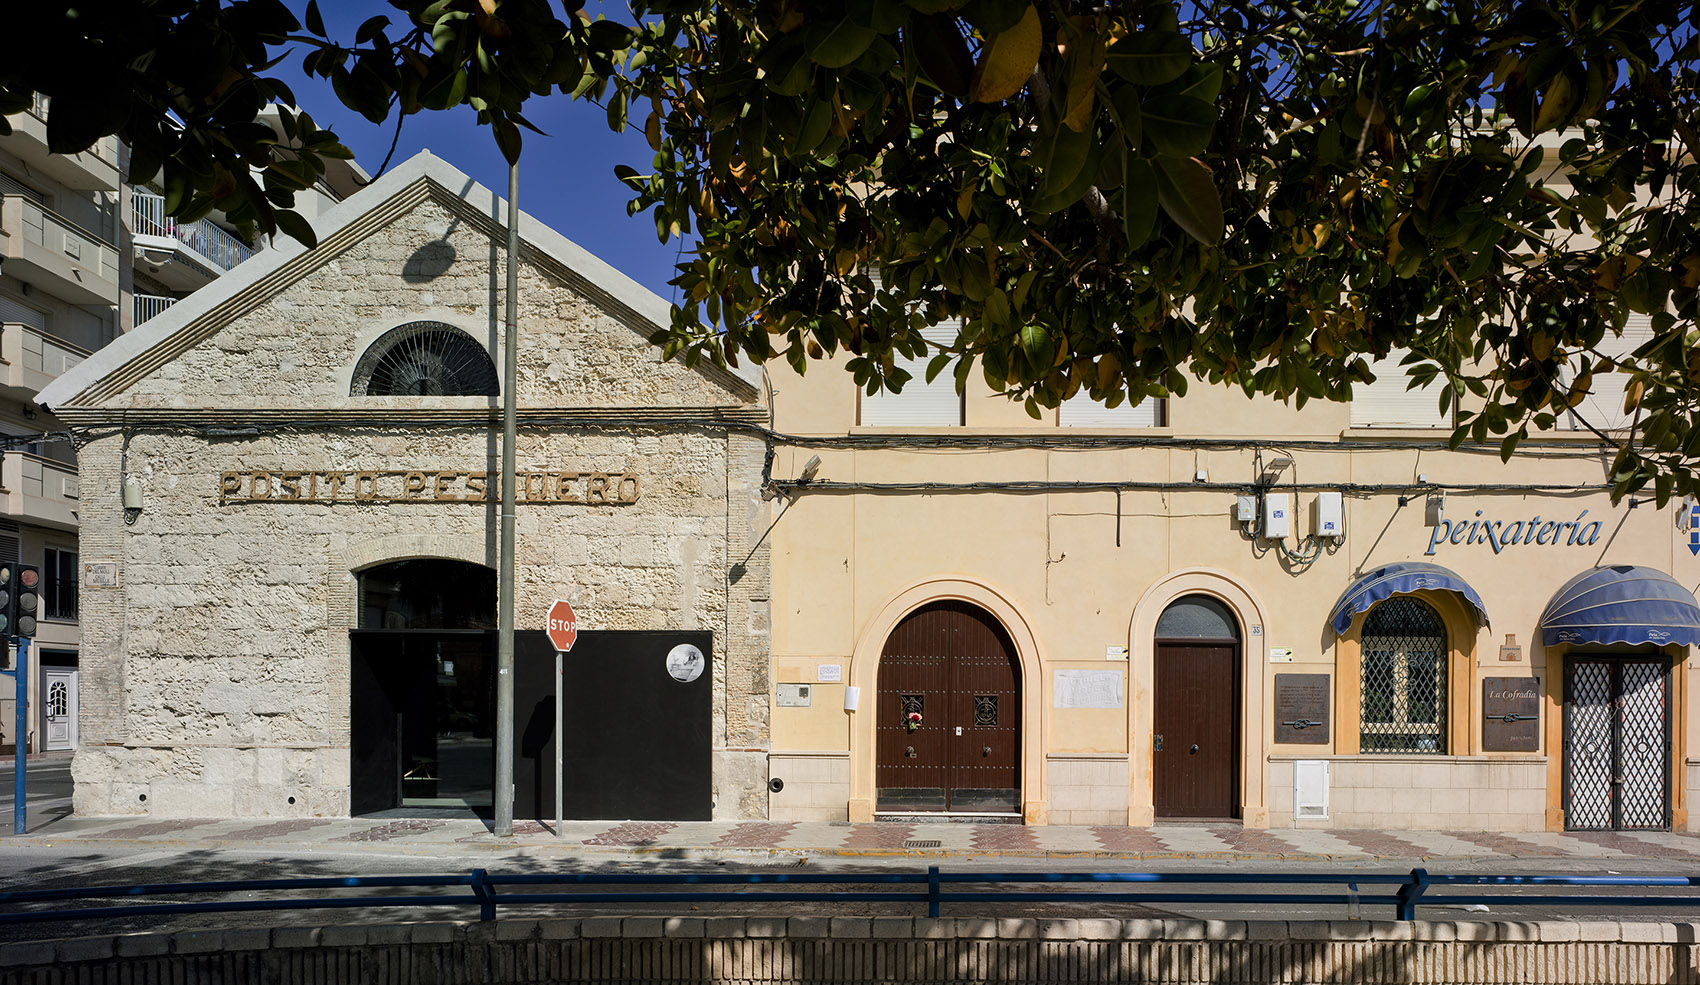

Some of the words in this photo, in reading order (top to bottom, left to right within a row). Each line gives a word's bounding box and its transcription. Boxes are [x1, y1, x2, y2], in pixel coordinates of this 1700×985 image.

[219, 471, 377, 501] POSITO
[1424, 509, 1603, 556] peixatería
[550, 618, 576, 632] STOP
[1489, 690, 1501, 698] La
